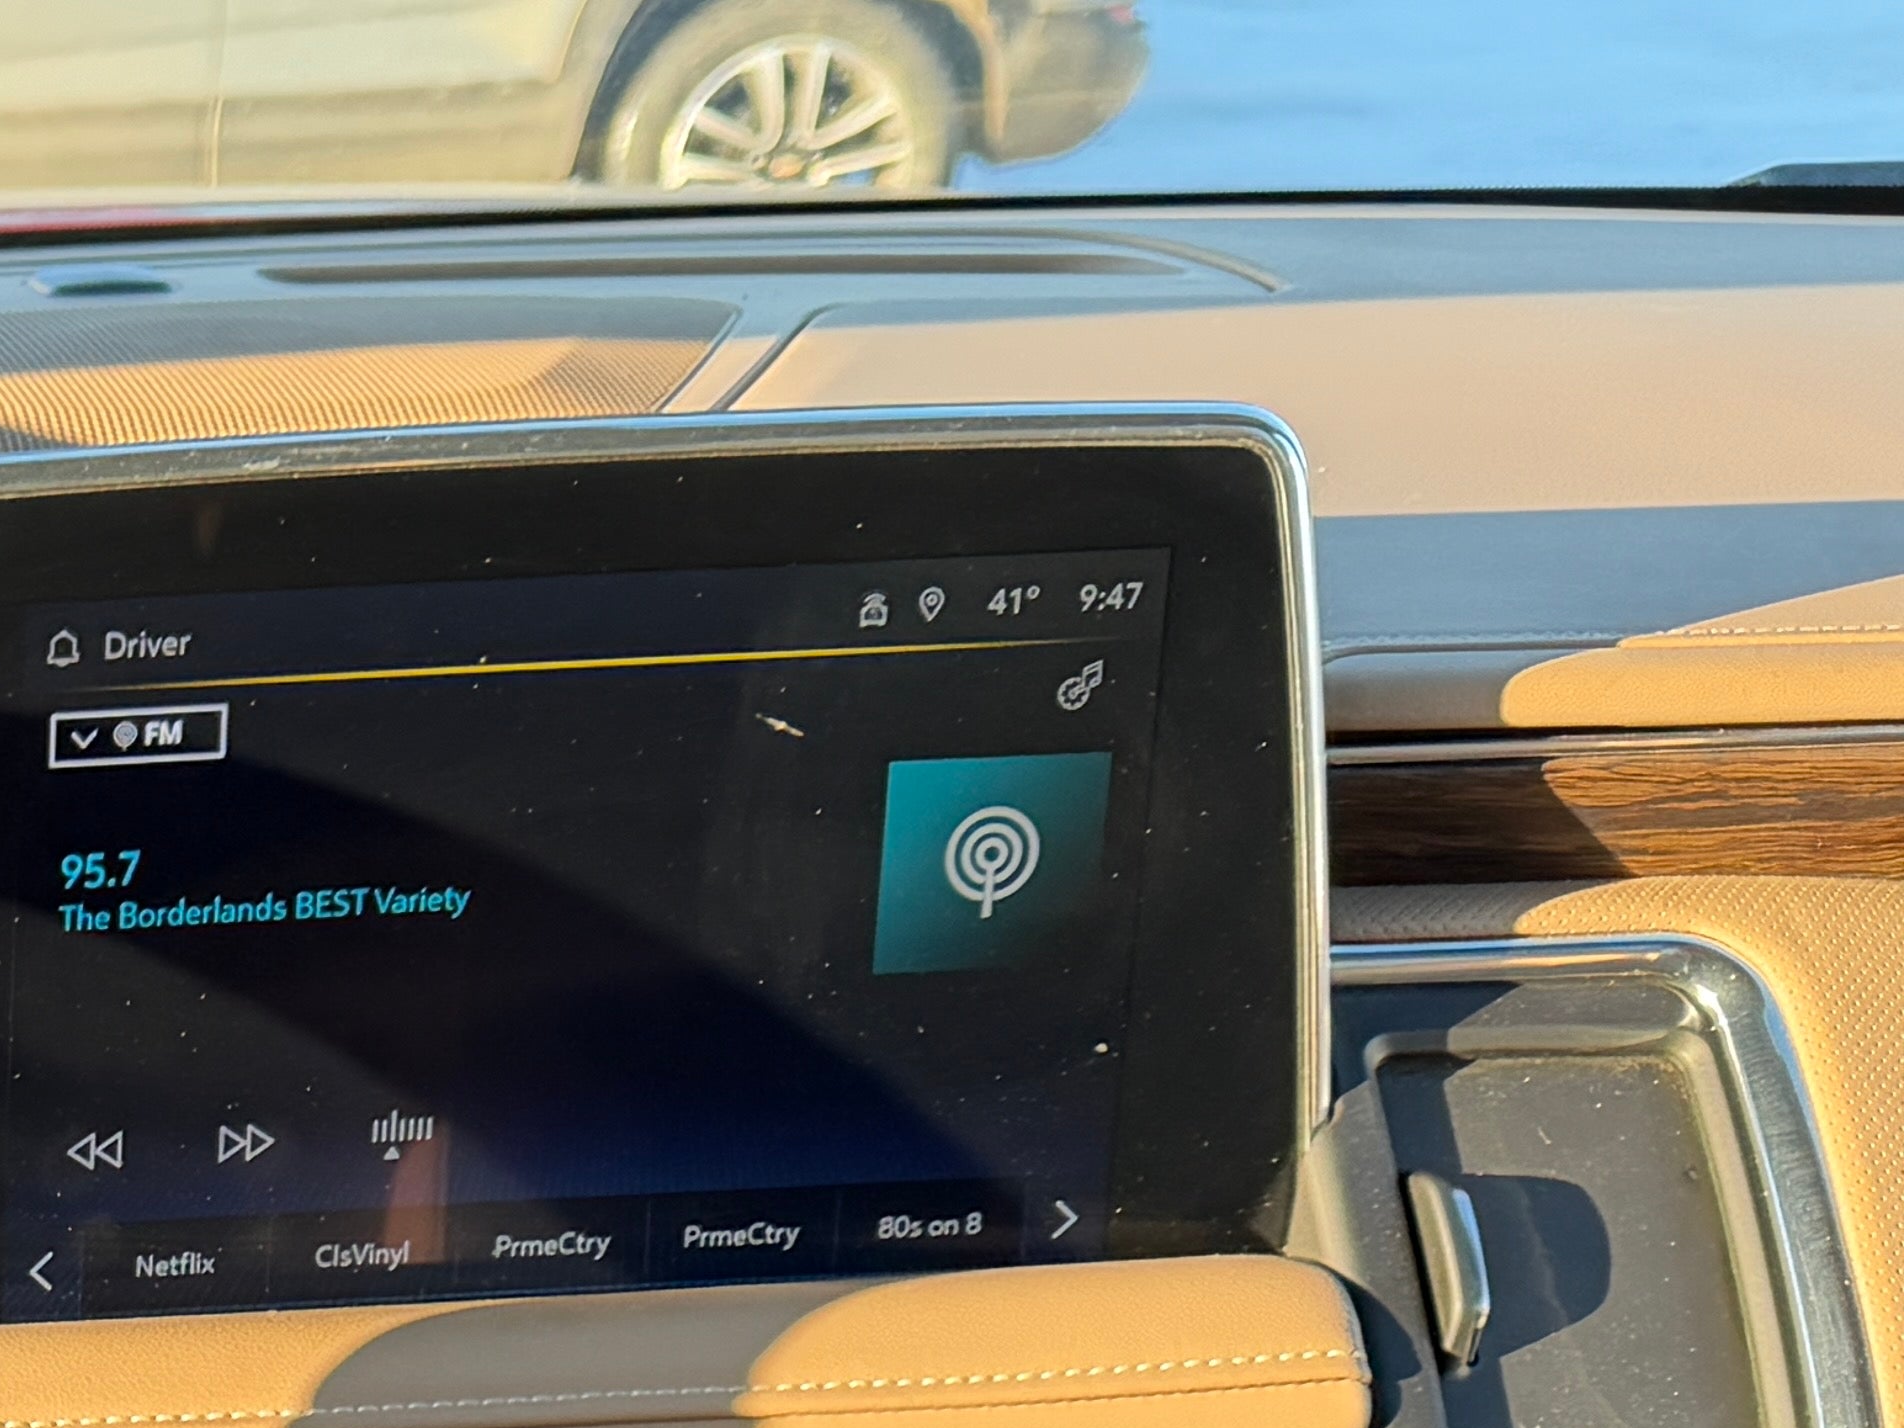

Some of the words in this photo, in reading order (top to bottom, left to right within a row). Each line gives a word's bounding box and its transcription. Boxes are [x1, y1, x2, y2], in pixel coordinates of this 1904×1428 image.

[1080, 582, 1144, 612] 9:47
[103, 630, 192, 662] Driver
[145, 720, 184, 748] FM
[60, 850, 141, 890] 95.7
[59, 903, 110, 933] The
[119, 894, 287, 929] Borderlands
[295, 888, 365, 918] BEST
[375, 885, 472, 921] Variety
[682, 1222, 800, 1252] PrmeCtry
[877, 1214, 922, 1240] 80s
[928, 1218, 961, 1239] on
[965, 1211, 982, 1236] 8
[495, 1231, 611, 1262] PrmeCtry
[135, 1251, 216, 1279] Netflix
